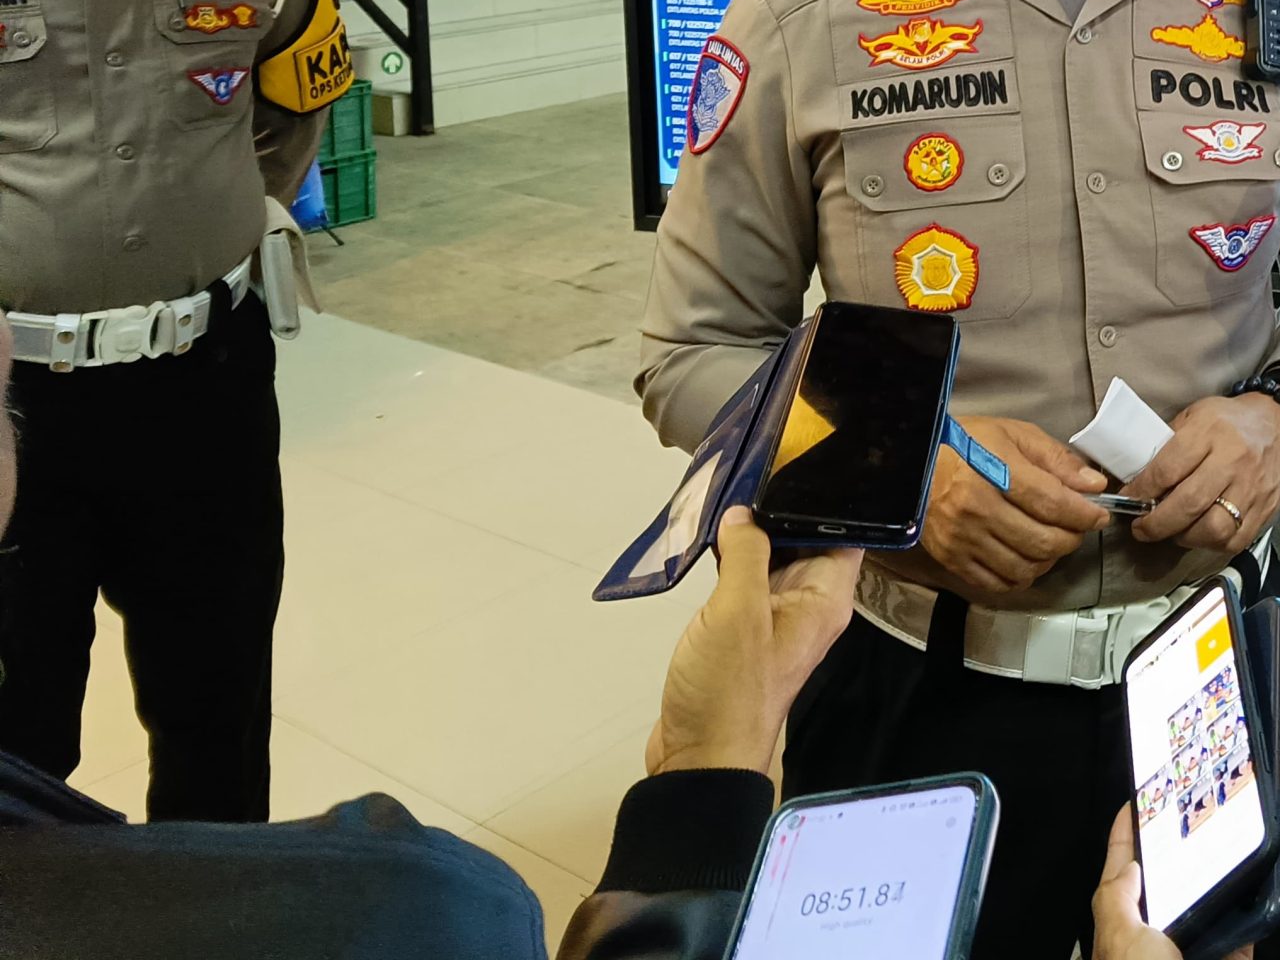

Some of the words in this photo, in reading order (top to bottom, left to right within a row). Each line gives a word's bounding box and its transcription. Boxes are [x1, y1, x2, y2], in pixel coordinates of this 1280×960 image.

[310, 80, 333, 100] OPS
[851, 70, 1008, 120] KOMARUDIN
[1150, 69, 1270, 114] POLRI
